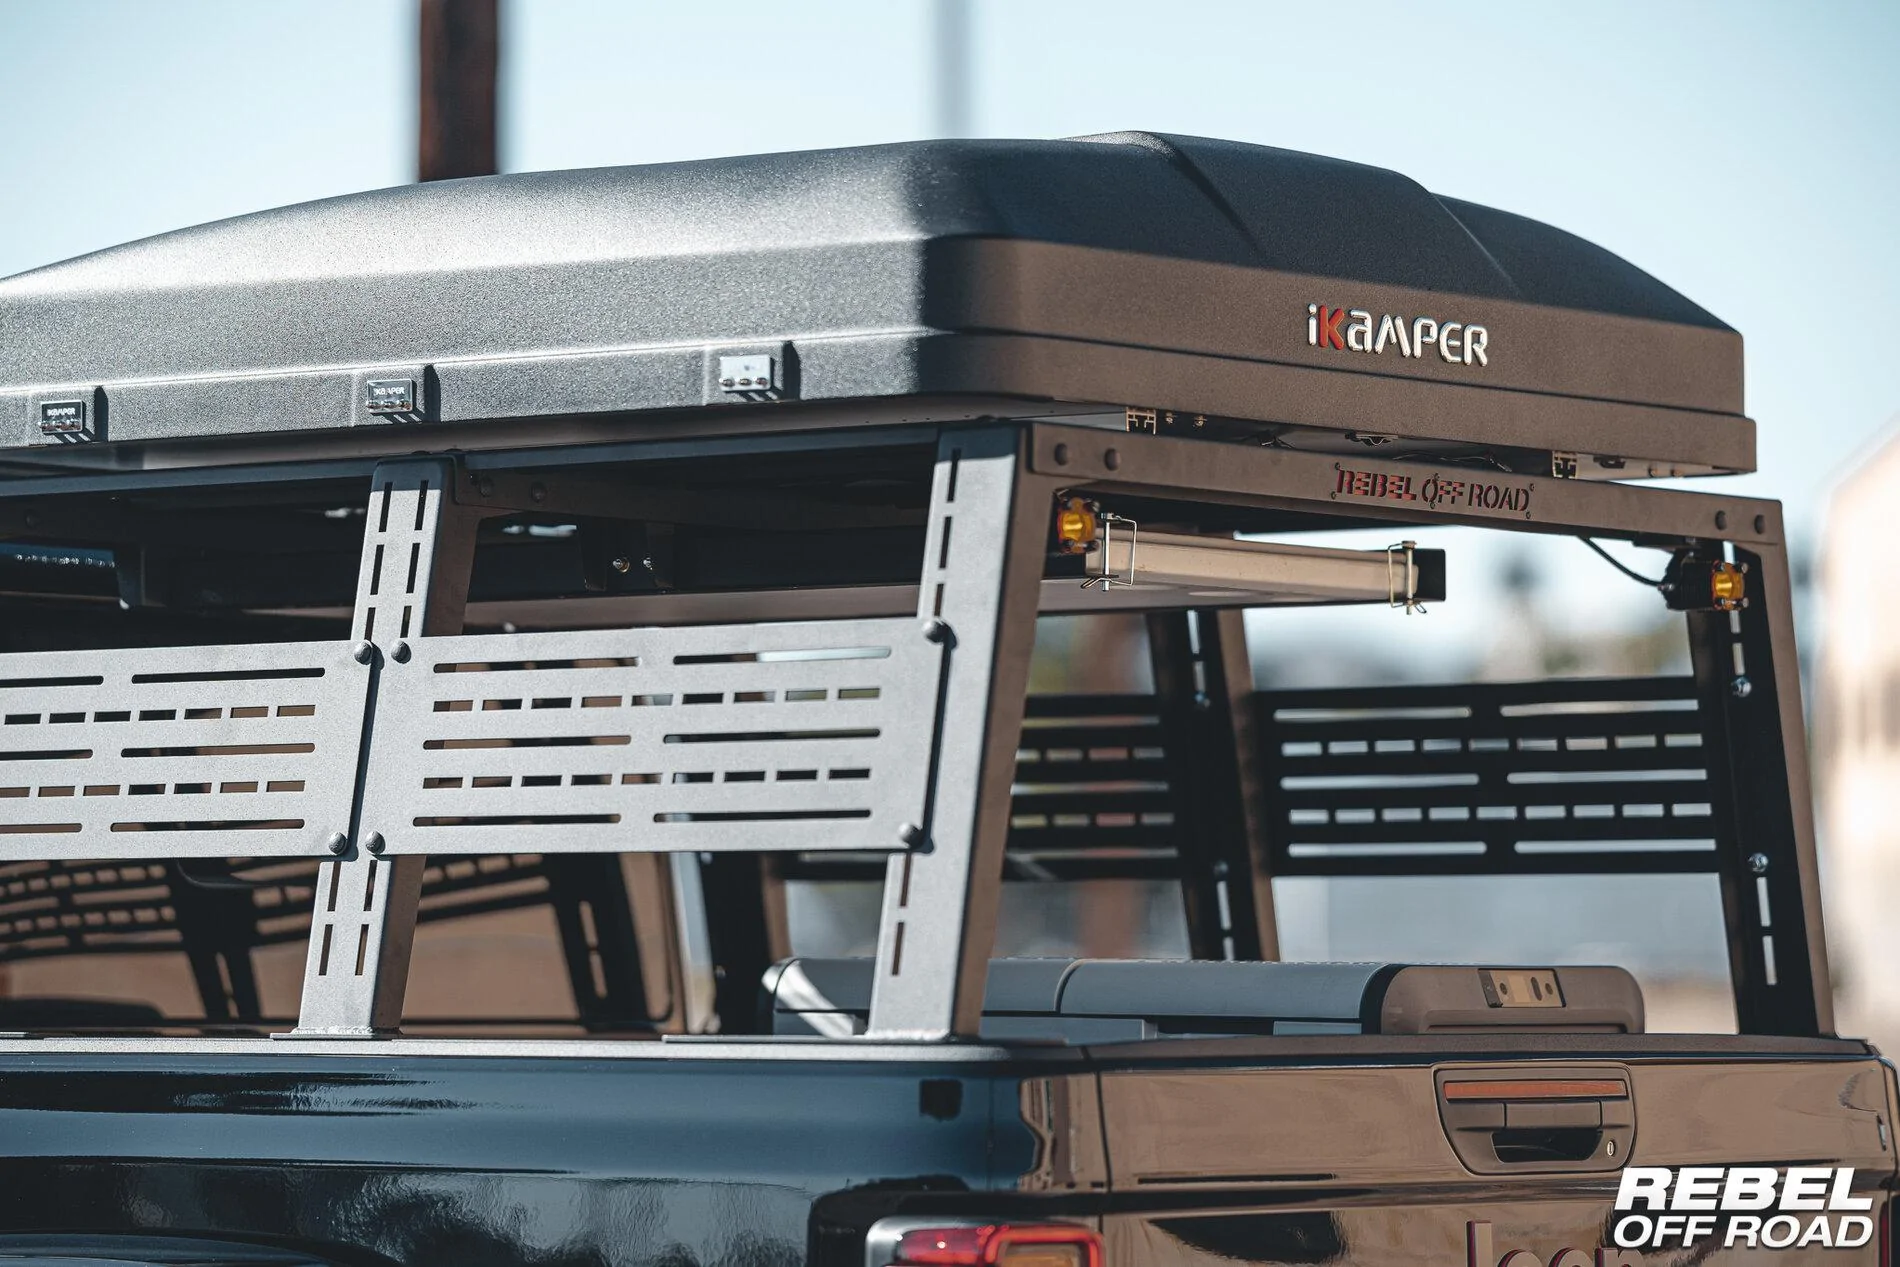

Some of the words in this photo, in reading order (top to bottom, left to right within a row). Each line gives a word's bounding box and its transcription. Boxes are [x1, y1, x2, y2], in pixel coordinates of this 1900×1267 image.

[1337, 469, 1417, 501] REBEL
[1421, 477, 1465, 504] OFF
[1468, 483, 1530, 512] ROAD
